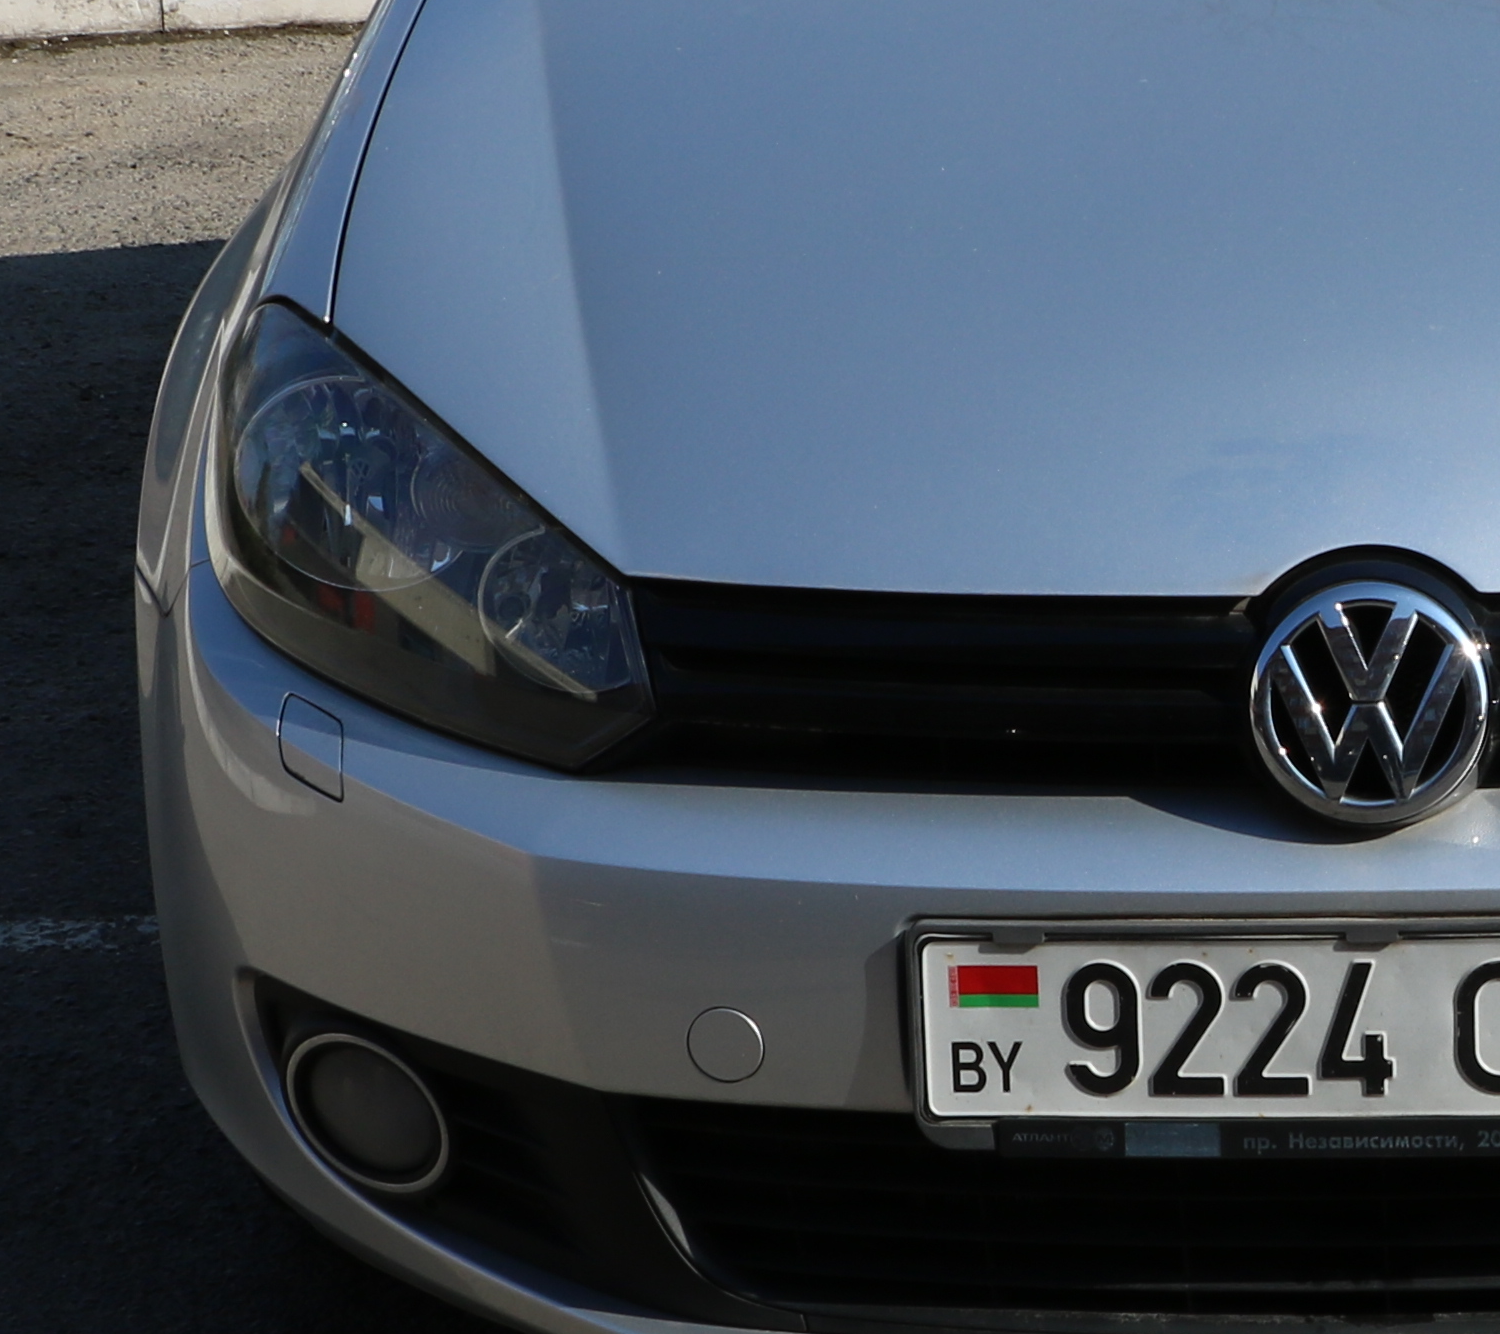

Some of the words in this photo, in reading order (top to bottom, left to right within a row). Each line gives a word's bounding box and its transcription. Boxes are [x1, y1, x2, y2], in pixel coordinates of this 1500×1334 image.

[1064, 959, 1393, 1098] 9224
[949, 1041, 1022, 1094] BY
[1243, 1135, 1276, 1153] пр.
[1288, 1131, 1466, 1151] Независимости,
